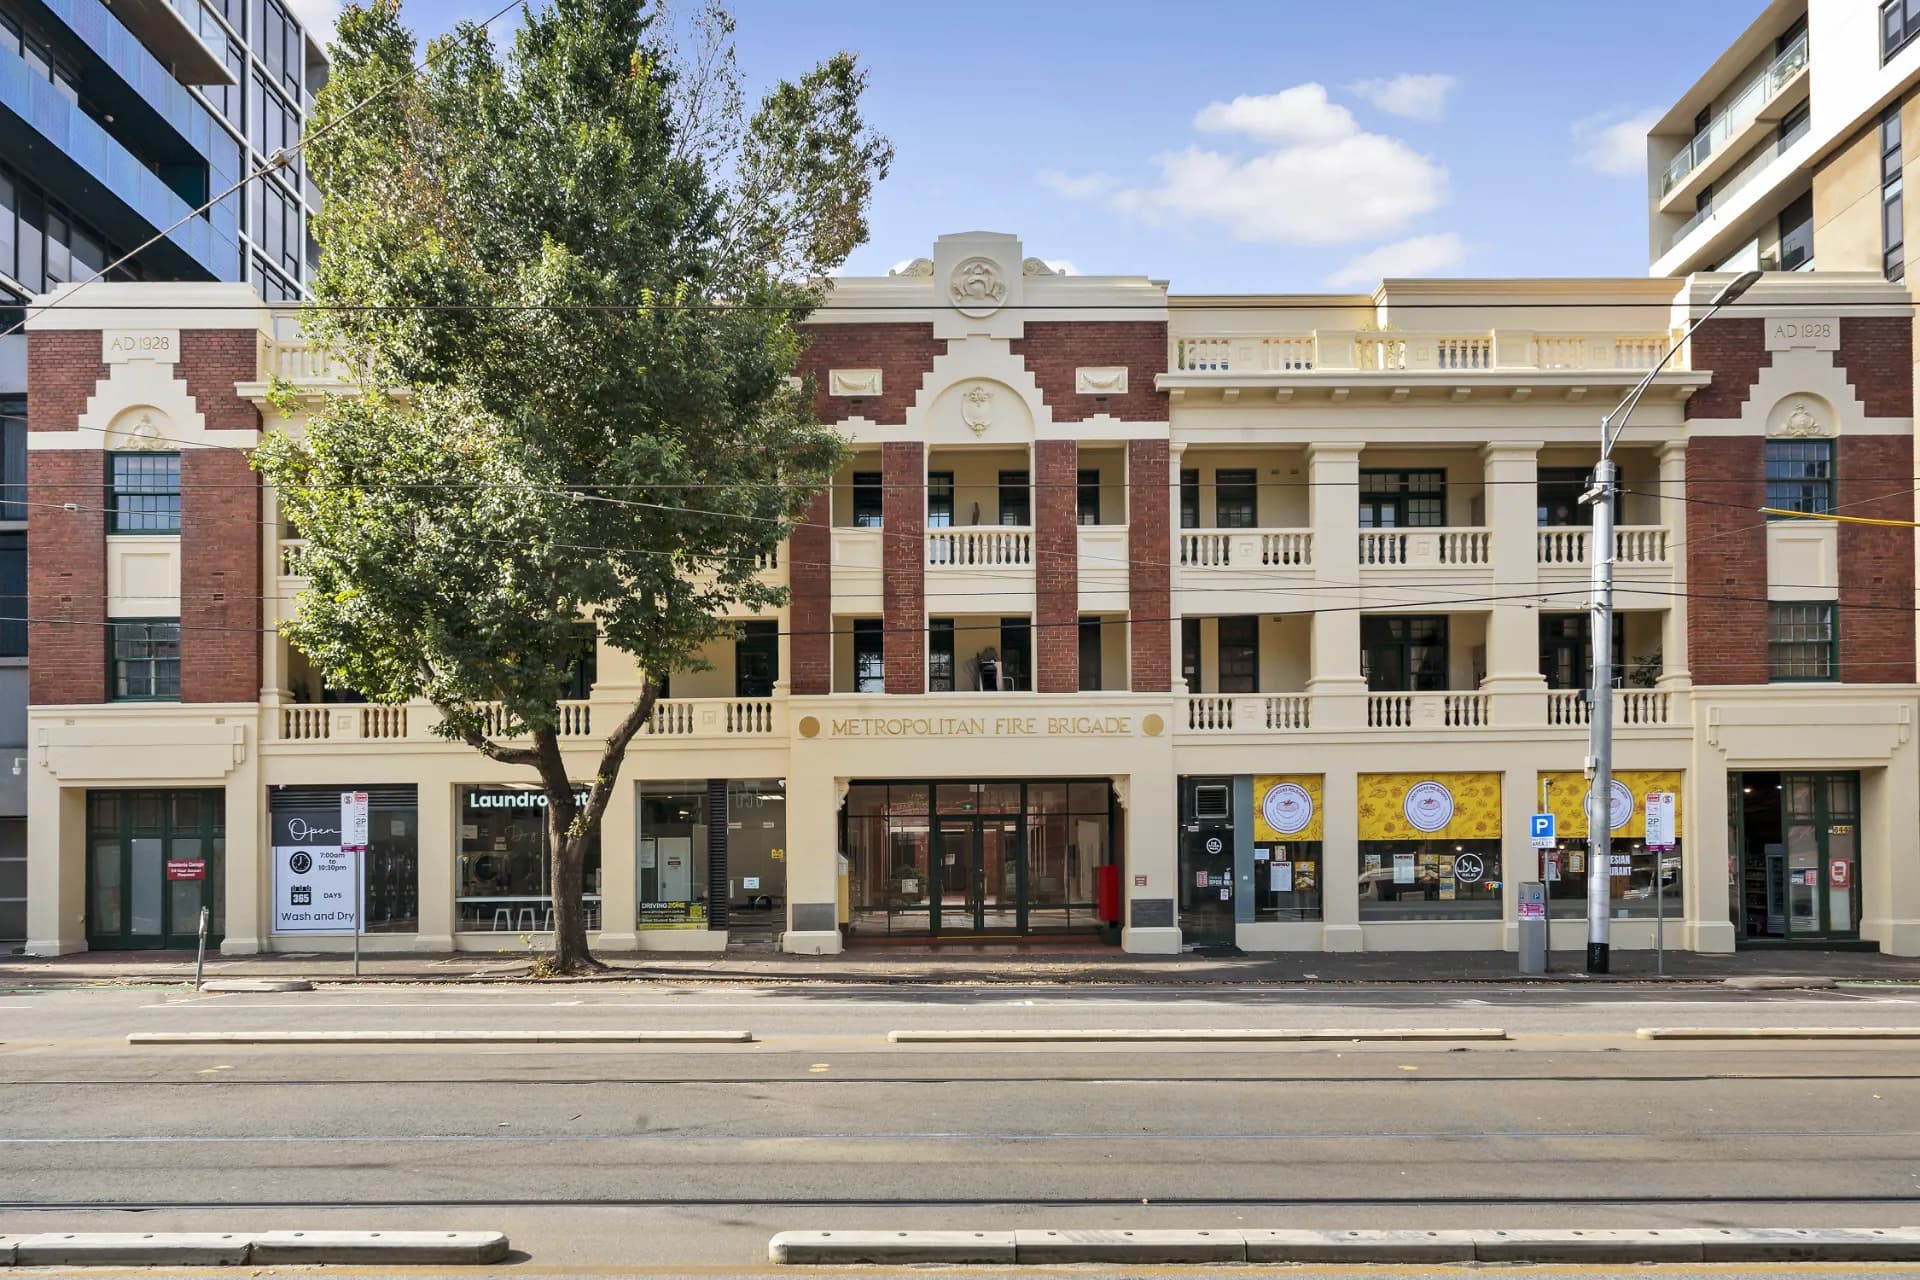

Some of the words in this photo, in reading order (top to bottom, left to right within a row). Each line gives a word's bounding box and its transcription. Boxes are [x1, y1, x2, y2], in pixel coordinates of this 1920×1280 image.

[1774, 324, 1798, 338] AD
[1801, 323, 1831, 338] 1928
[111, 336, 136, 351] AD
[140, 336, 170, 351] 1928
[831, 717, 986, 737] METROPOLITAN
[995, 717, 1038, 735] FIRE
[1047, 716, 1133, 734] BRIGADE
[470, 791, 589, 808] Laundrot
[288, 818, 343, 842] Open
[1536, 818, 1549, 834] P
[1610, 855, 1631, 864] ESIAN
[1610, 866, 1632, 876] URANT
[292, 894, 310, 904] 365
[668, 901, 686, 909] ZONE
[281, 912, 311, 921] Wash
[313, 912, 335, 921] and
[337, 911, 355, 923] Dry
